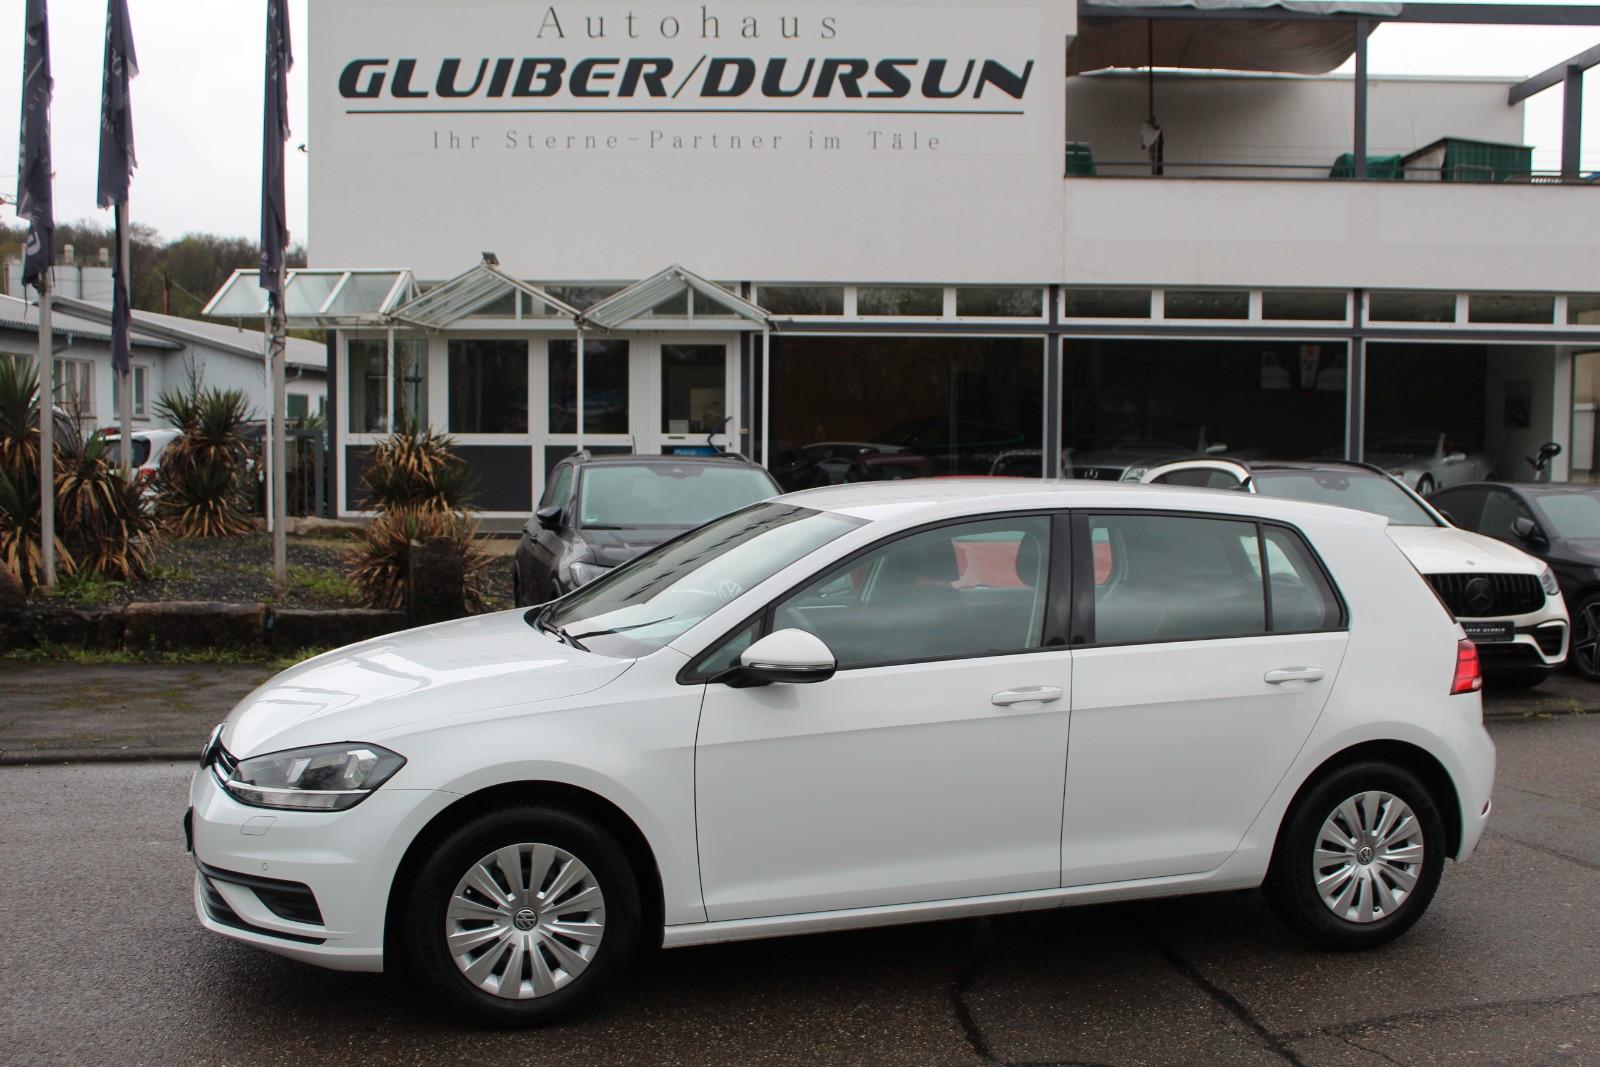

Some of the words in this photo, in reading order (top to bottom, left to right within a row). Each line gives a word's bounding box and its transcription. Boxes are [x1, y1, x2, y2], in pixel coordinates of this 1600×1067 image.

[537, 4, 837, 40] Autohaus
[433, 130, 480, 150] Ihr
[505, 130, 783, 150] Sterne-Partner
[808, 130, 842, 150] im
[867, 130, 940, 151] Täle
